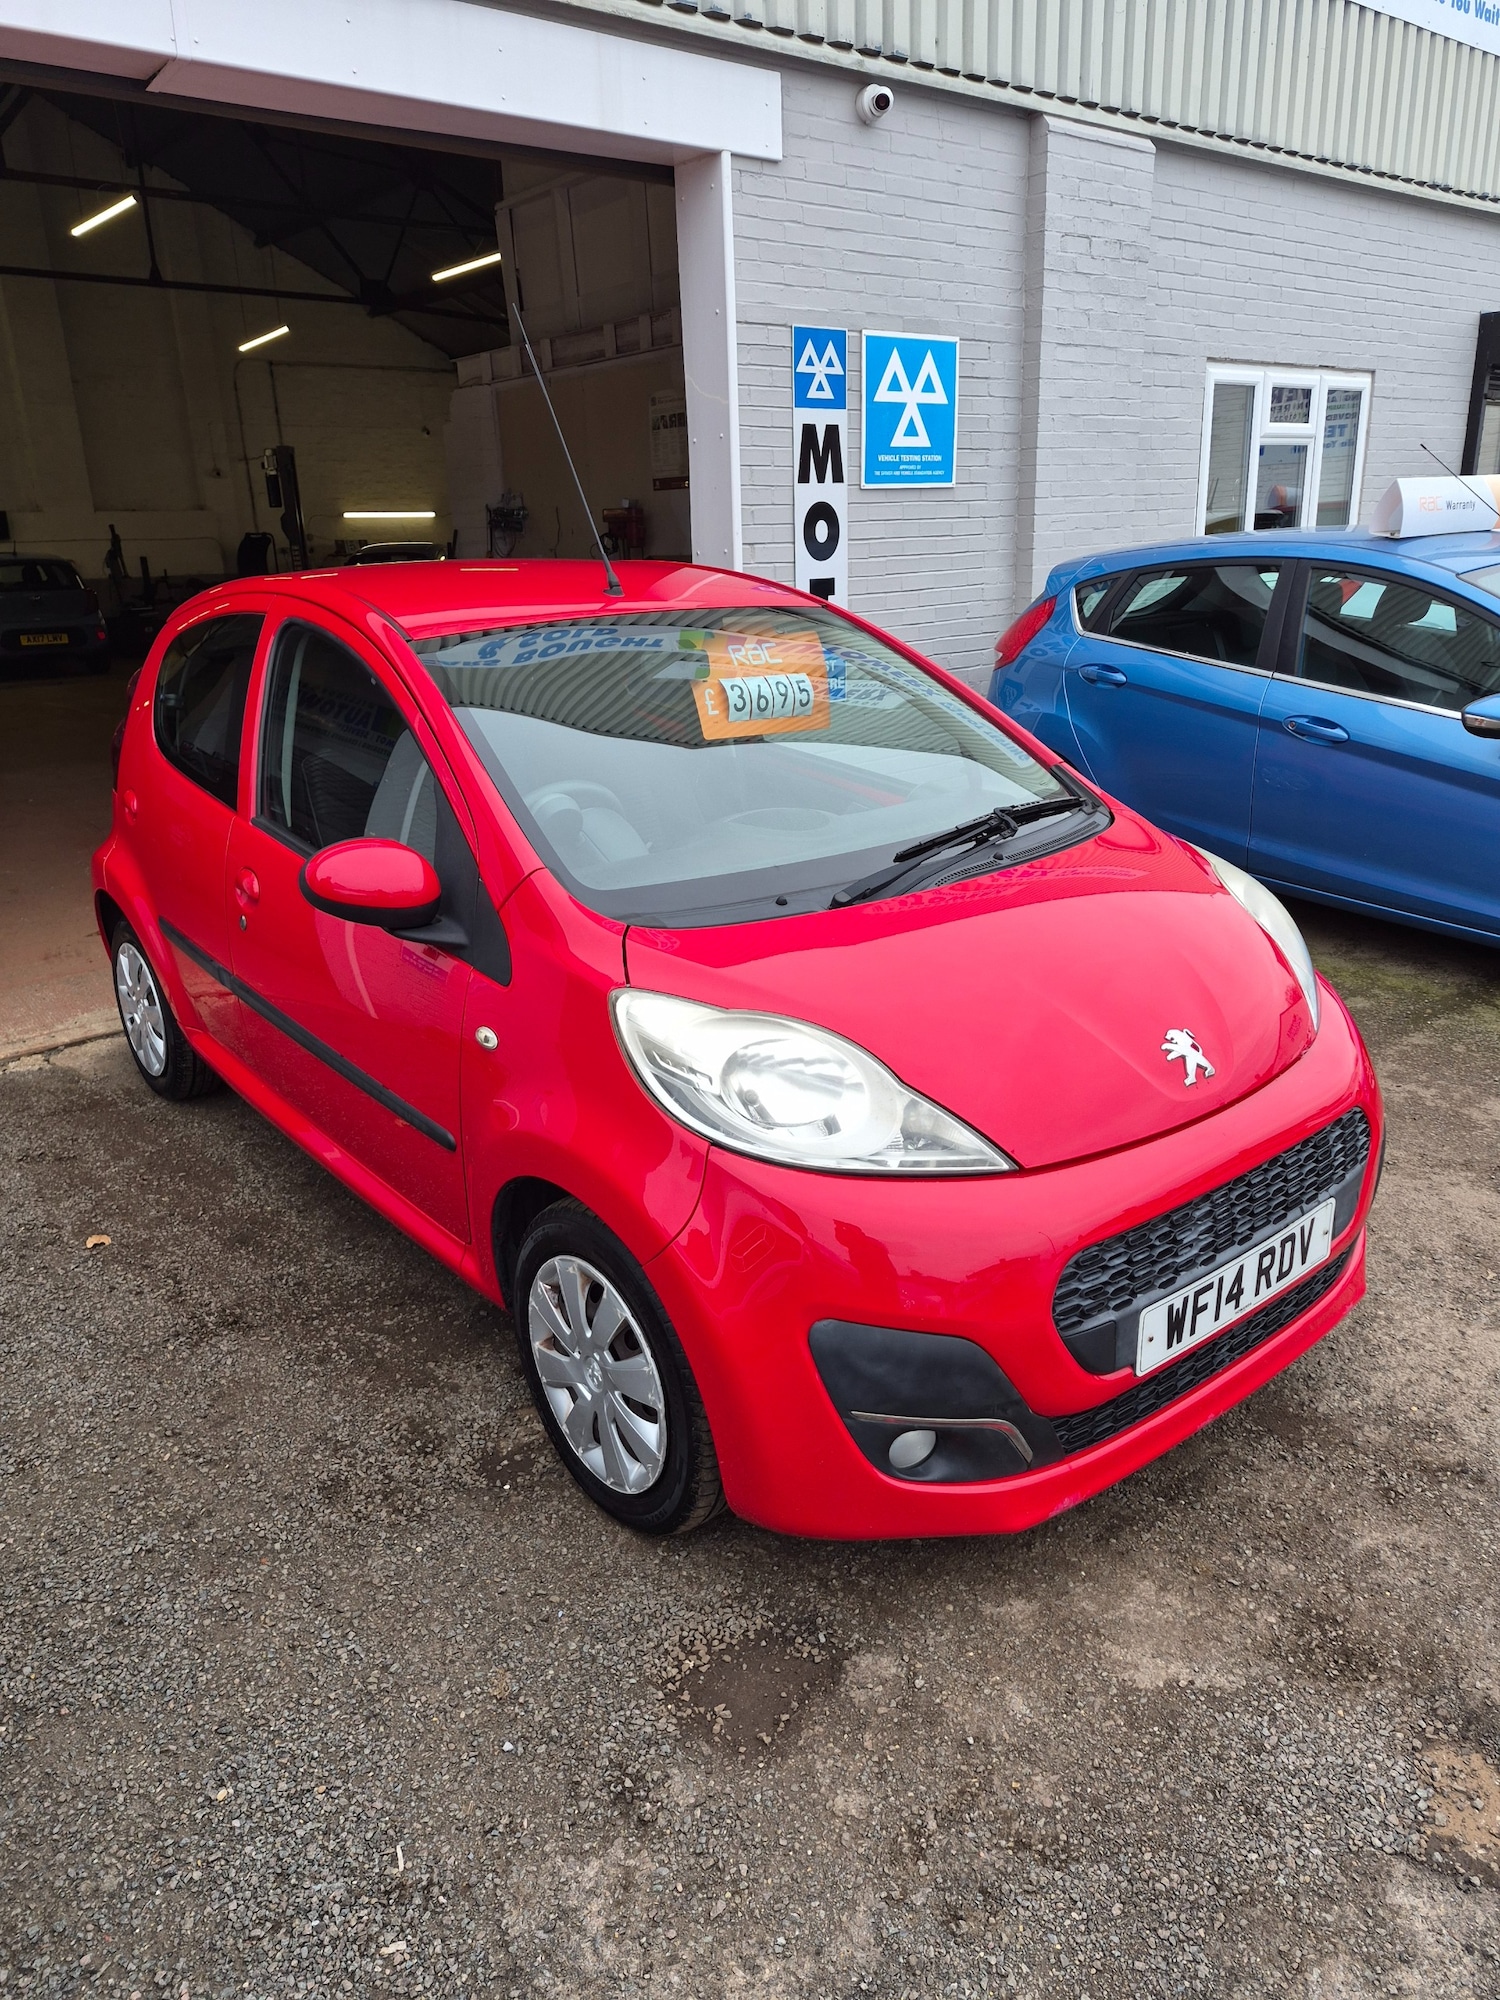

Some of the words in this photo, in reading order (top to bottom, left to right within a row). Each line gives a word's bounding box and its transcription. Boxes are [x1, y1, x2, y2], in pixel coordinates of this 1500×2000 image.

[1475, 0, 1500, 26] Wait
[878, 454, 899, 462] VEHICLE
[900, 454, 921, 462] TESTING
[922, 454, 942, 462] STATION
[1445, 500, 1476, 511] Warranty
[1166, 1263, 1245, 1351] WF14
[1254, 1217, 1315, 1298] RDV
